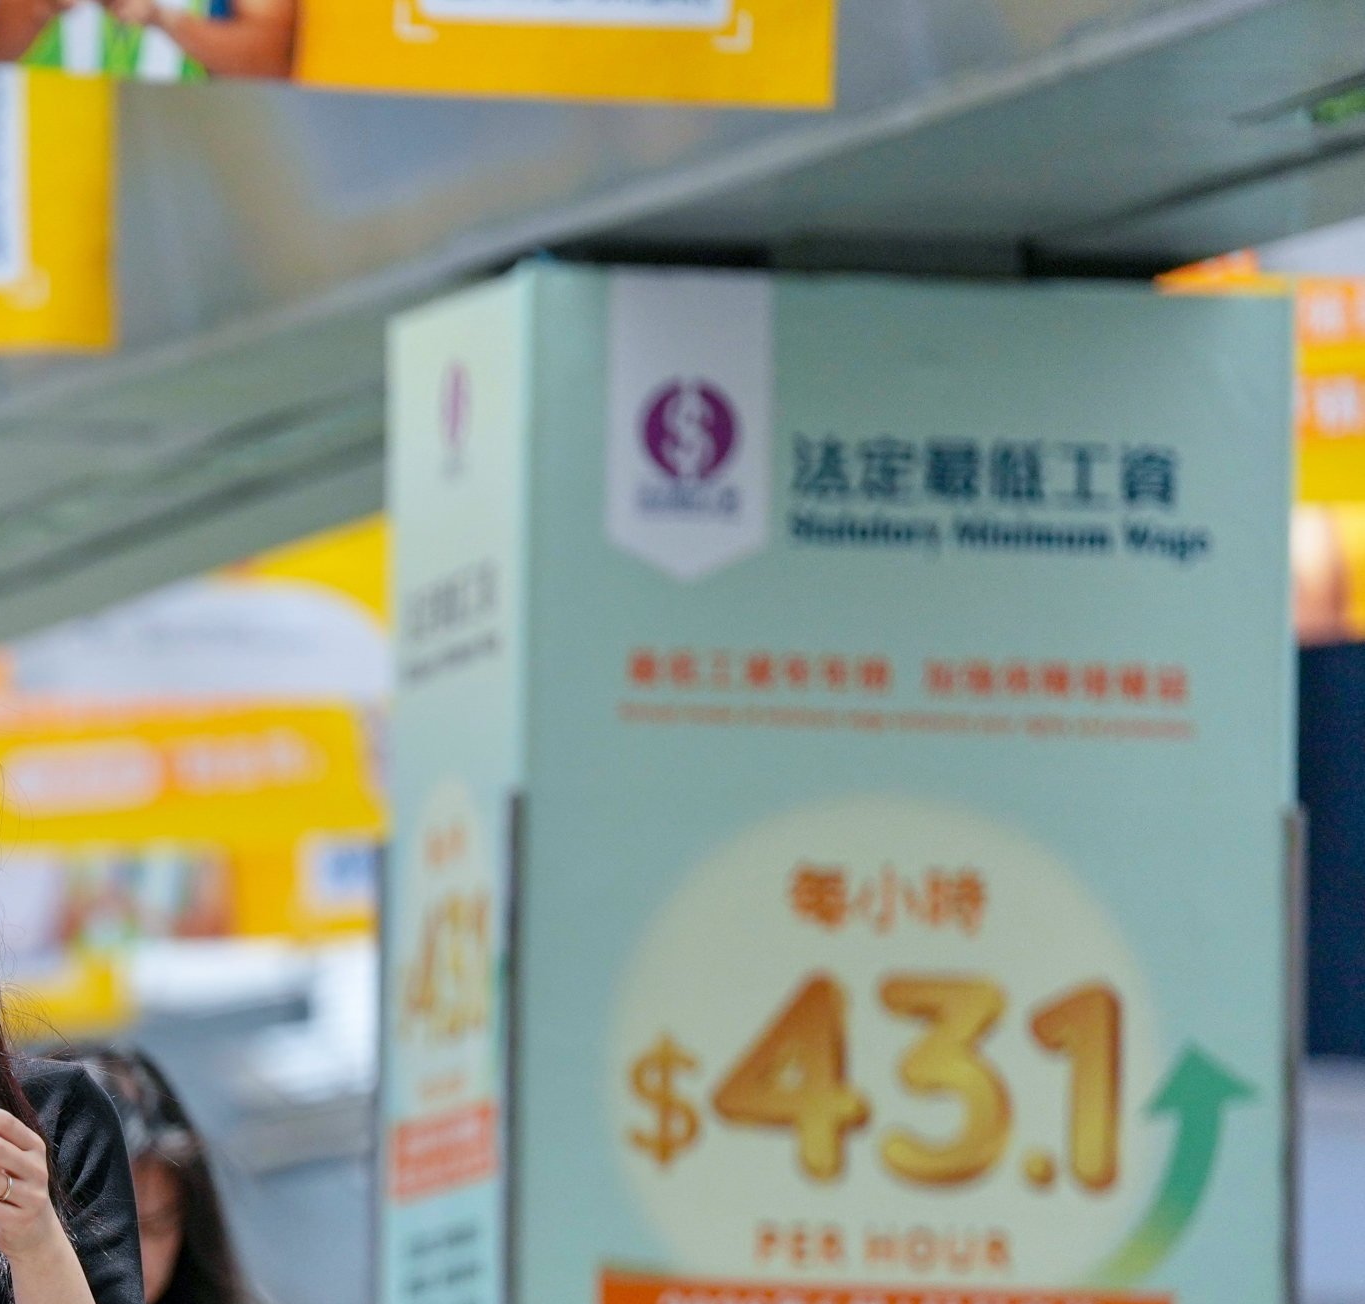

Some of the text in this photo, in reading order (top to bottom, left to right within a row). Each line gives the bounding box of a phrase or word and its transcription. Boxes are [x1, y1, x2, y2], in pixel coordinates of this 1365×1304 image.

[791, 434, 1178, 508] 法定最低工資
[951, 514, 1116, 553] Minimum
[789, 862, 987, 934] 每小時
[626, 970, 1124, 1194] $43.1
[754, 1222, 1014, 1272] PER HOUR
